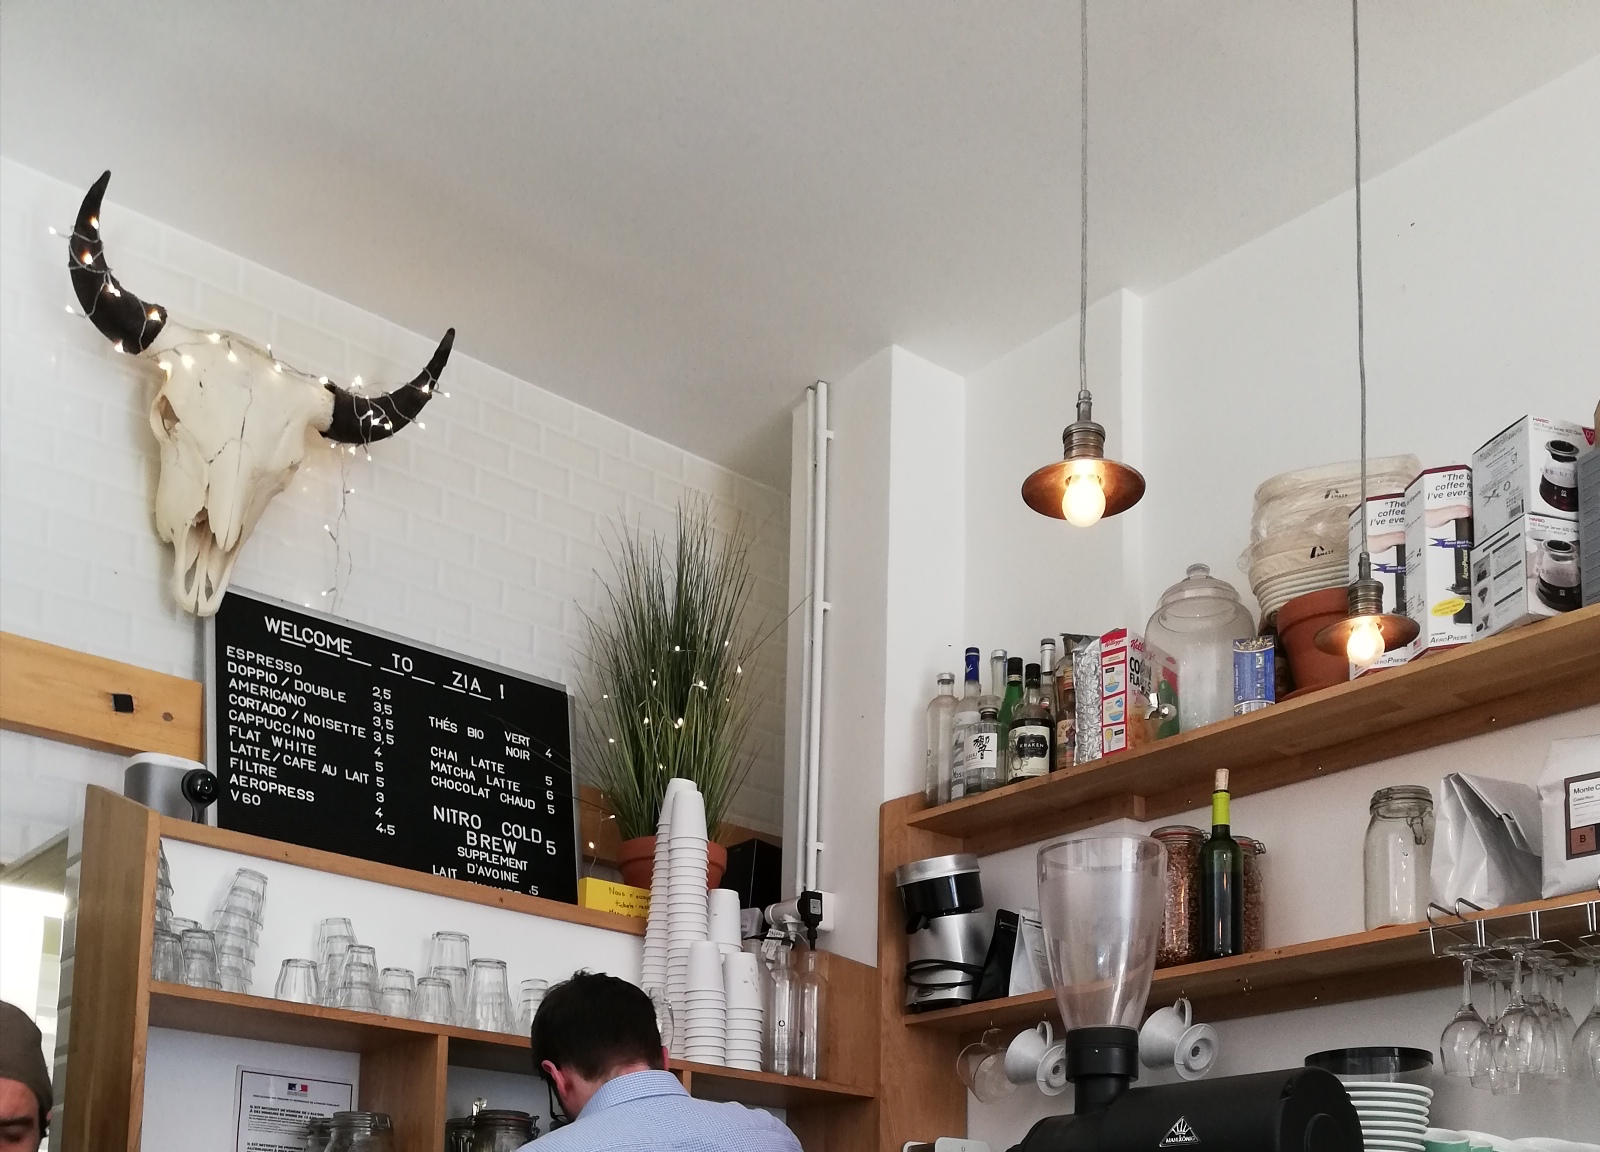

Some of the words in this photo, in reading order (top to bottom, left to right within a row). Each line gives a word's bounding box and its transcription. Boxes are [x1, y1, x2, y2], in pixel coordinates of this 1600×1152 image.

[1427, 491, 1444, 500] I've
[1446, 490, 1467, 498] ever
[1435, 481, 1465, 491] coffee
[1370, 518, 1386, 526] I've
[1389, 516, 1405, 524] eve
[1377, 508, 1406, 518] coffee
[264, 615, 353, 656] WELCOME
[226, 645, 303, 676] ESPRESSO
[372, 686, 392, 700] 2,5
[227, 661, 278, 684] DOPPIO
[294, 679, 347, 703] DOUBLE
[373, 701, 393, 715] 3,5
[391, 653, 413, 673] TO
[452, 670, 482, 693] ZIA
[228, 677, 307, 707] AMERICANO
[372, 715, 394, 730] 3,5
[228, 693, 287, 718] CORTADO
[303, 712, 367, 739] NOISETTE
[373, 730, 395, 745] 3,5
[228, 709, 316, 741] CAPPUCCINO
[373, 746, 383, 758] 4
[428, 715, 458, 734] THÉS
[467, 726, 485, 740] BIO
[504, 730, 531, 748] VERT
[229, 724, 261, 743] FLAT
[271, 734, 317, 757] WHITE
[375, 761, 384, 773] 5
[505, 745, 531, 761] NOIR
[545, 748, 553, 759] 4
[229, 756, 278, 779] FILTRE
[375, 791, 385, 803] 3
[321, 763, 338, 777] AU
[345, 768, 370, 785] LAIT
[376, 776, 385, 788] 5
[430, 745, 458, 763] CHAI
[470, 755, 506, 775] LATTE
[545, 775, 553, 787] 5
[430, 759, 476, 782] MATCHA
[486, 774, 521, 793] LATTE
[546, 790, 554, 801] 6
[229, 773, 315, 803] AEROPRESS
[374, 807, 384, 819] 4
[430, 775, 491, 799] CHOCOLAT
[499, 792, 536, 811] CHAUD
[547, 804, 555, 815] 5
[1573, 785, 1595, 795] Monte
[432, 804, 482, 830] NITRO
[501, 821, 542, 844] COLD
[1579, 834, 1587, 844] B
[457, 845, 528, 872] SUPPLEMENT
[466, 830, 517, 856] BREW
[546, 839, 557, 856] 5
[432, 864, 458, 880] LAIT
[466, 862, 520, 884] D'AVOINE
